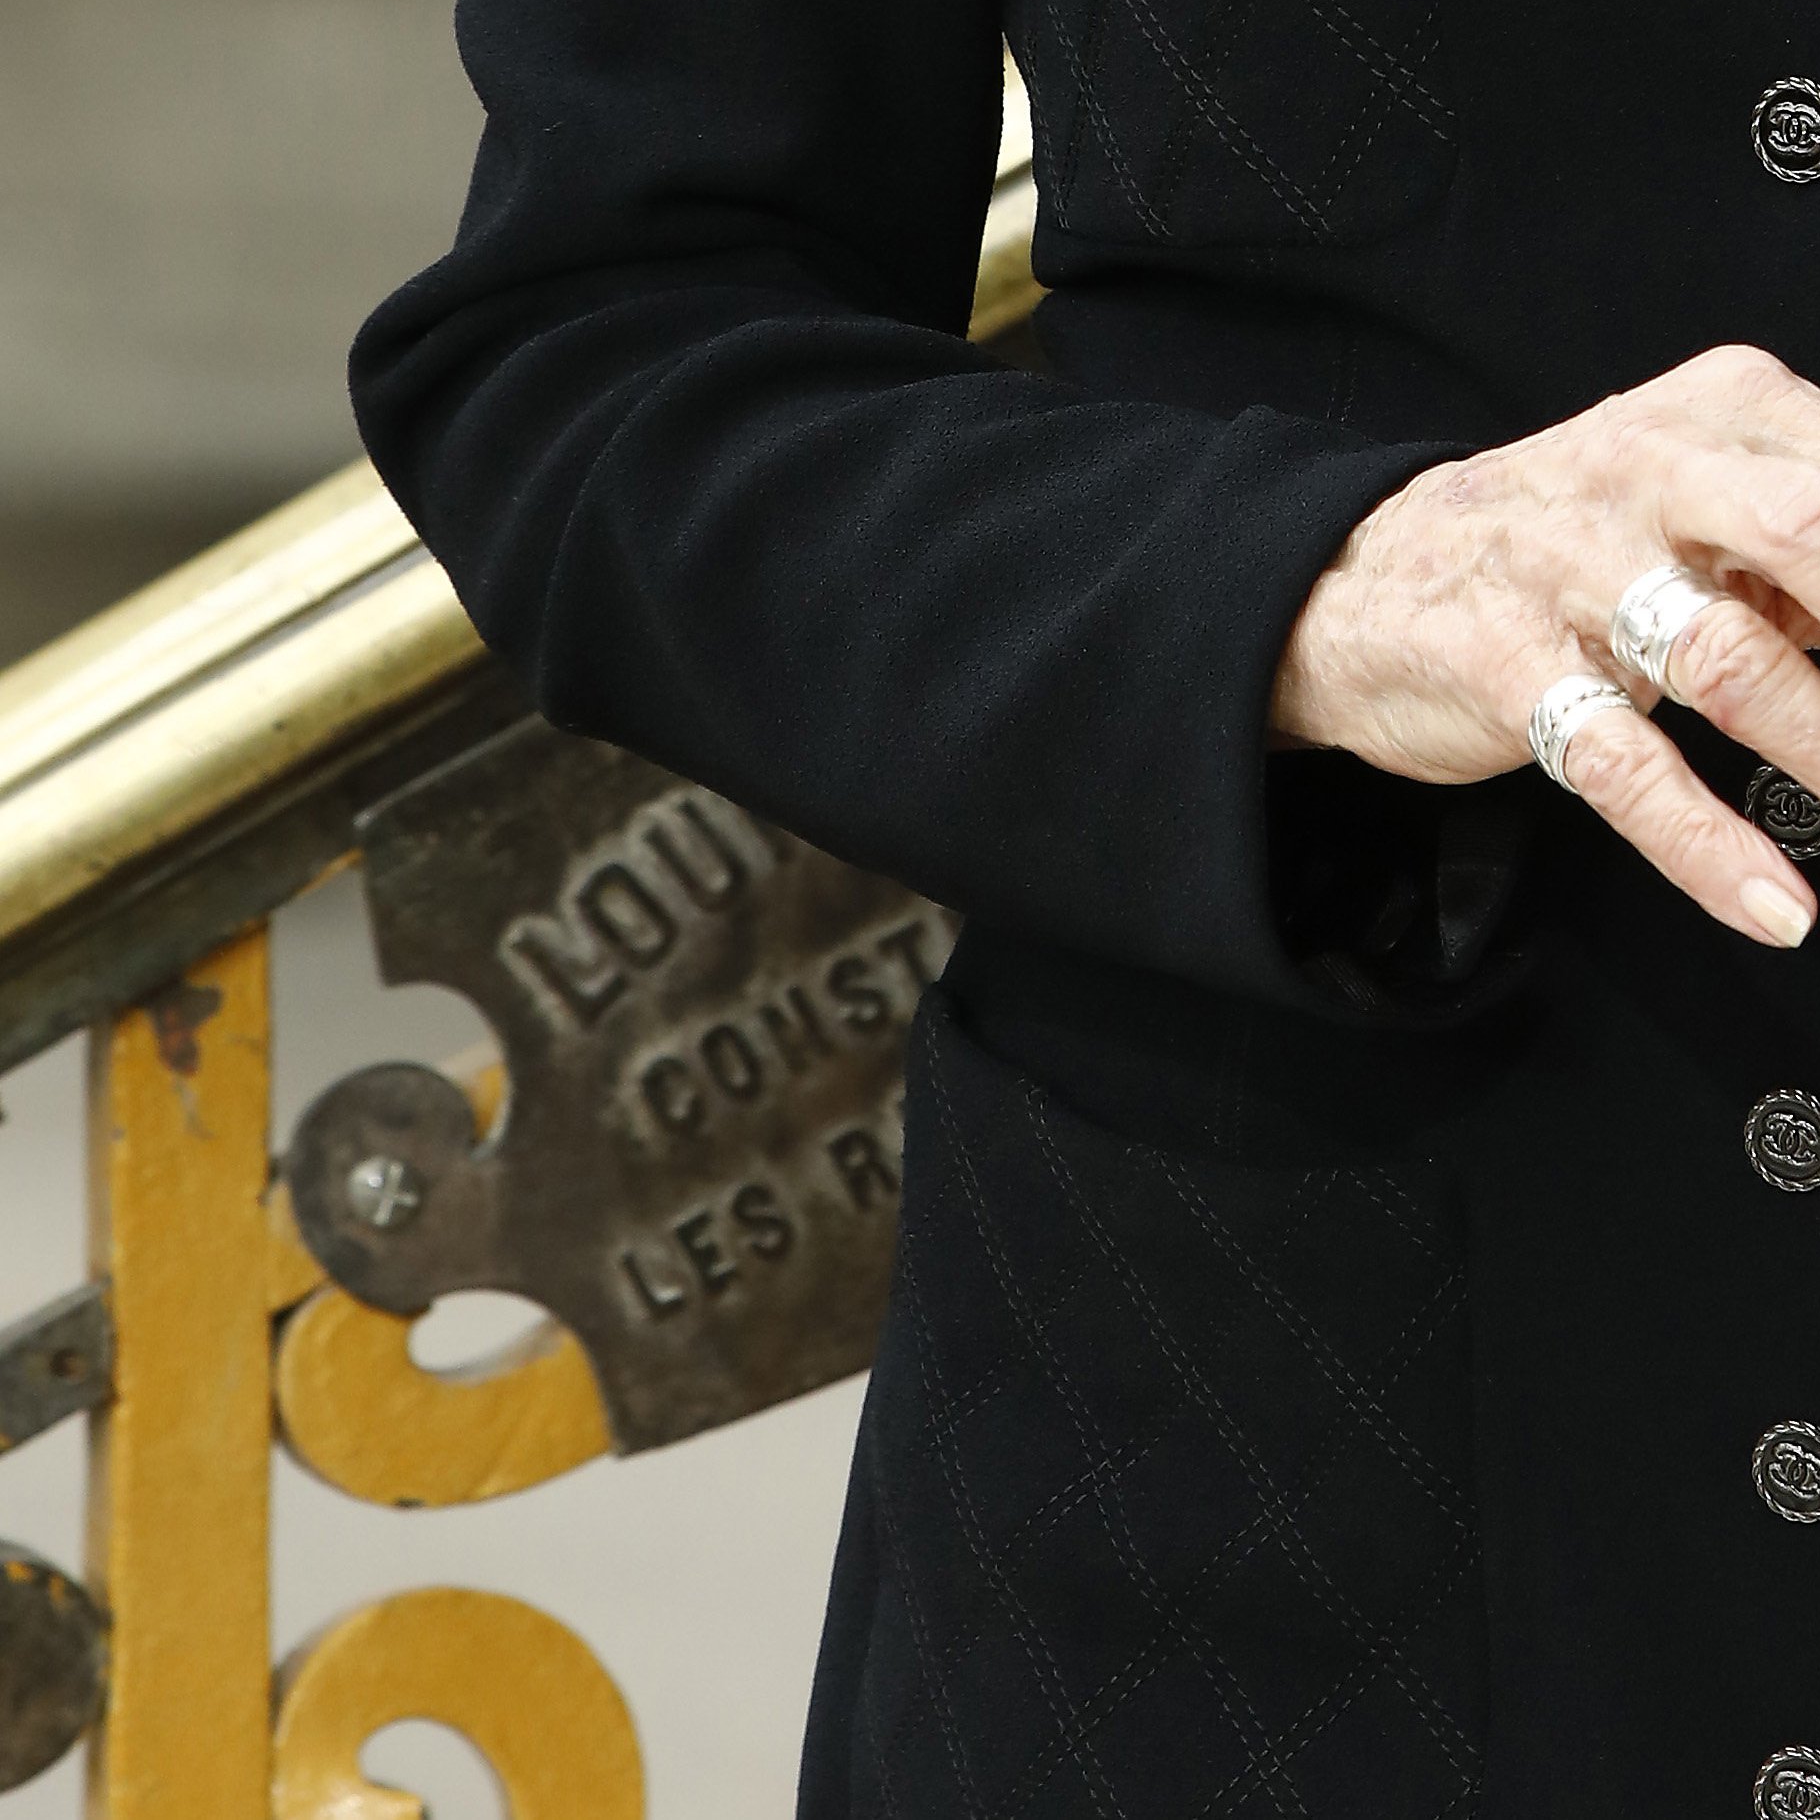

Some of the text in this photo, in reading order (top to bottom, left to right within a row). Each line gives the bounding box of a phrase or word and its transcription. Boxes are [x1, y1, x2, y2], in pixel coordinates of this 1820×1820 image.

[506, 791, 790, 1029] LOU
[620, 1096, 906, 1317] LES R
